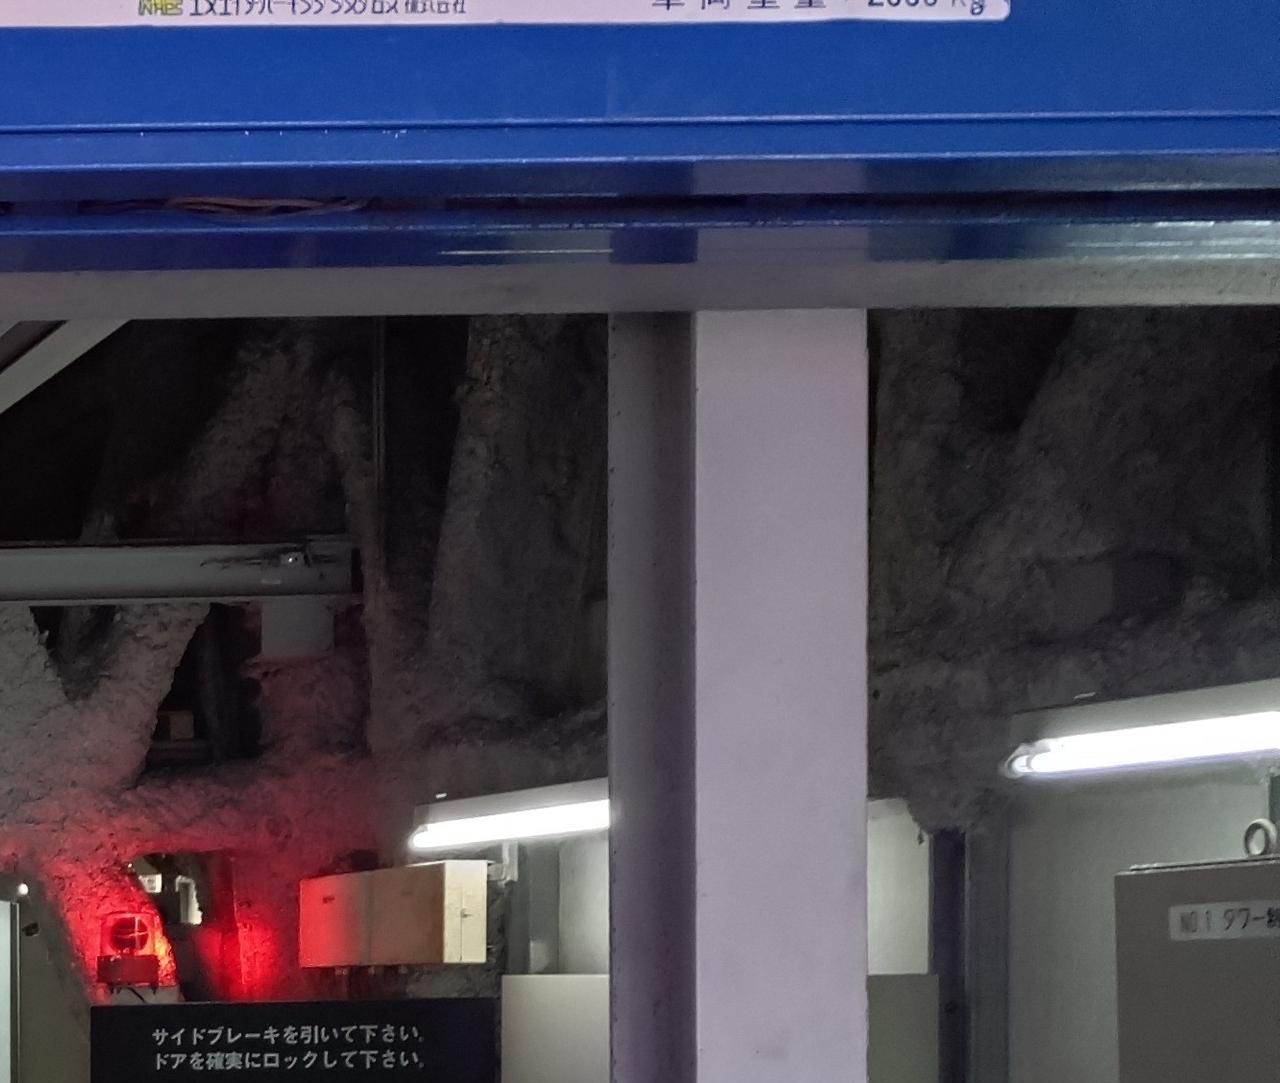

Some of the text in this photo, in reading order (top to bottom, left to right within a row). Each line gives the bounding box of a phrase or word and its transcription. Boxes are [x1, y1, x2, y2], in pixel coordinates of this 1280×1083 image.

[151, 1024, 424, 1046] サイドブレーキを引いて下さい。
[155, 1049, 425, 1070] ドアを確実にロックして下さい。
